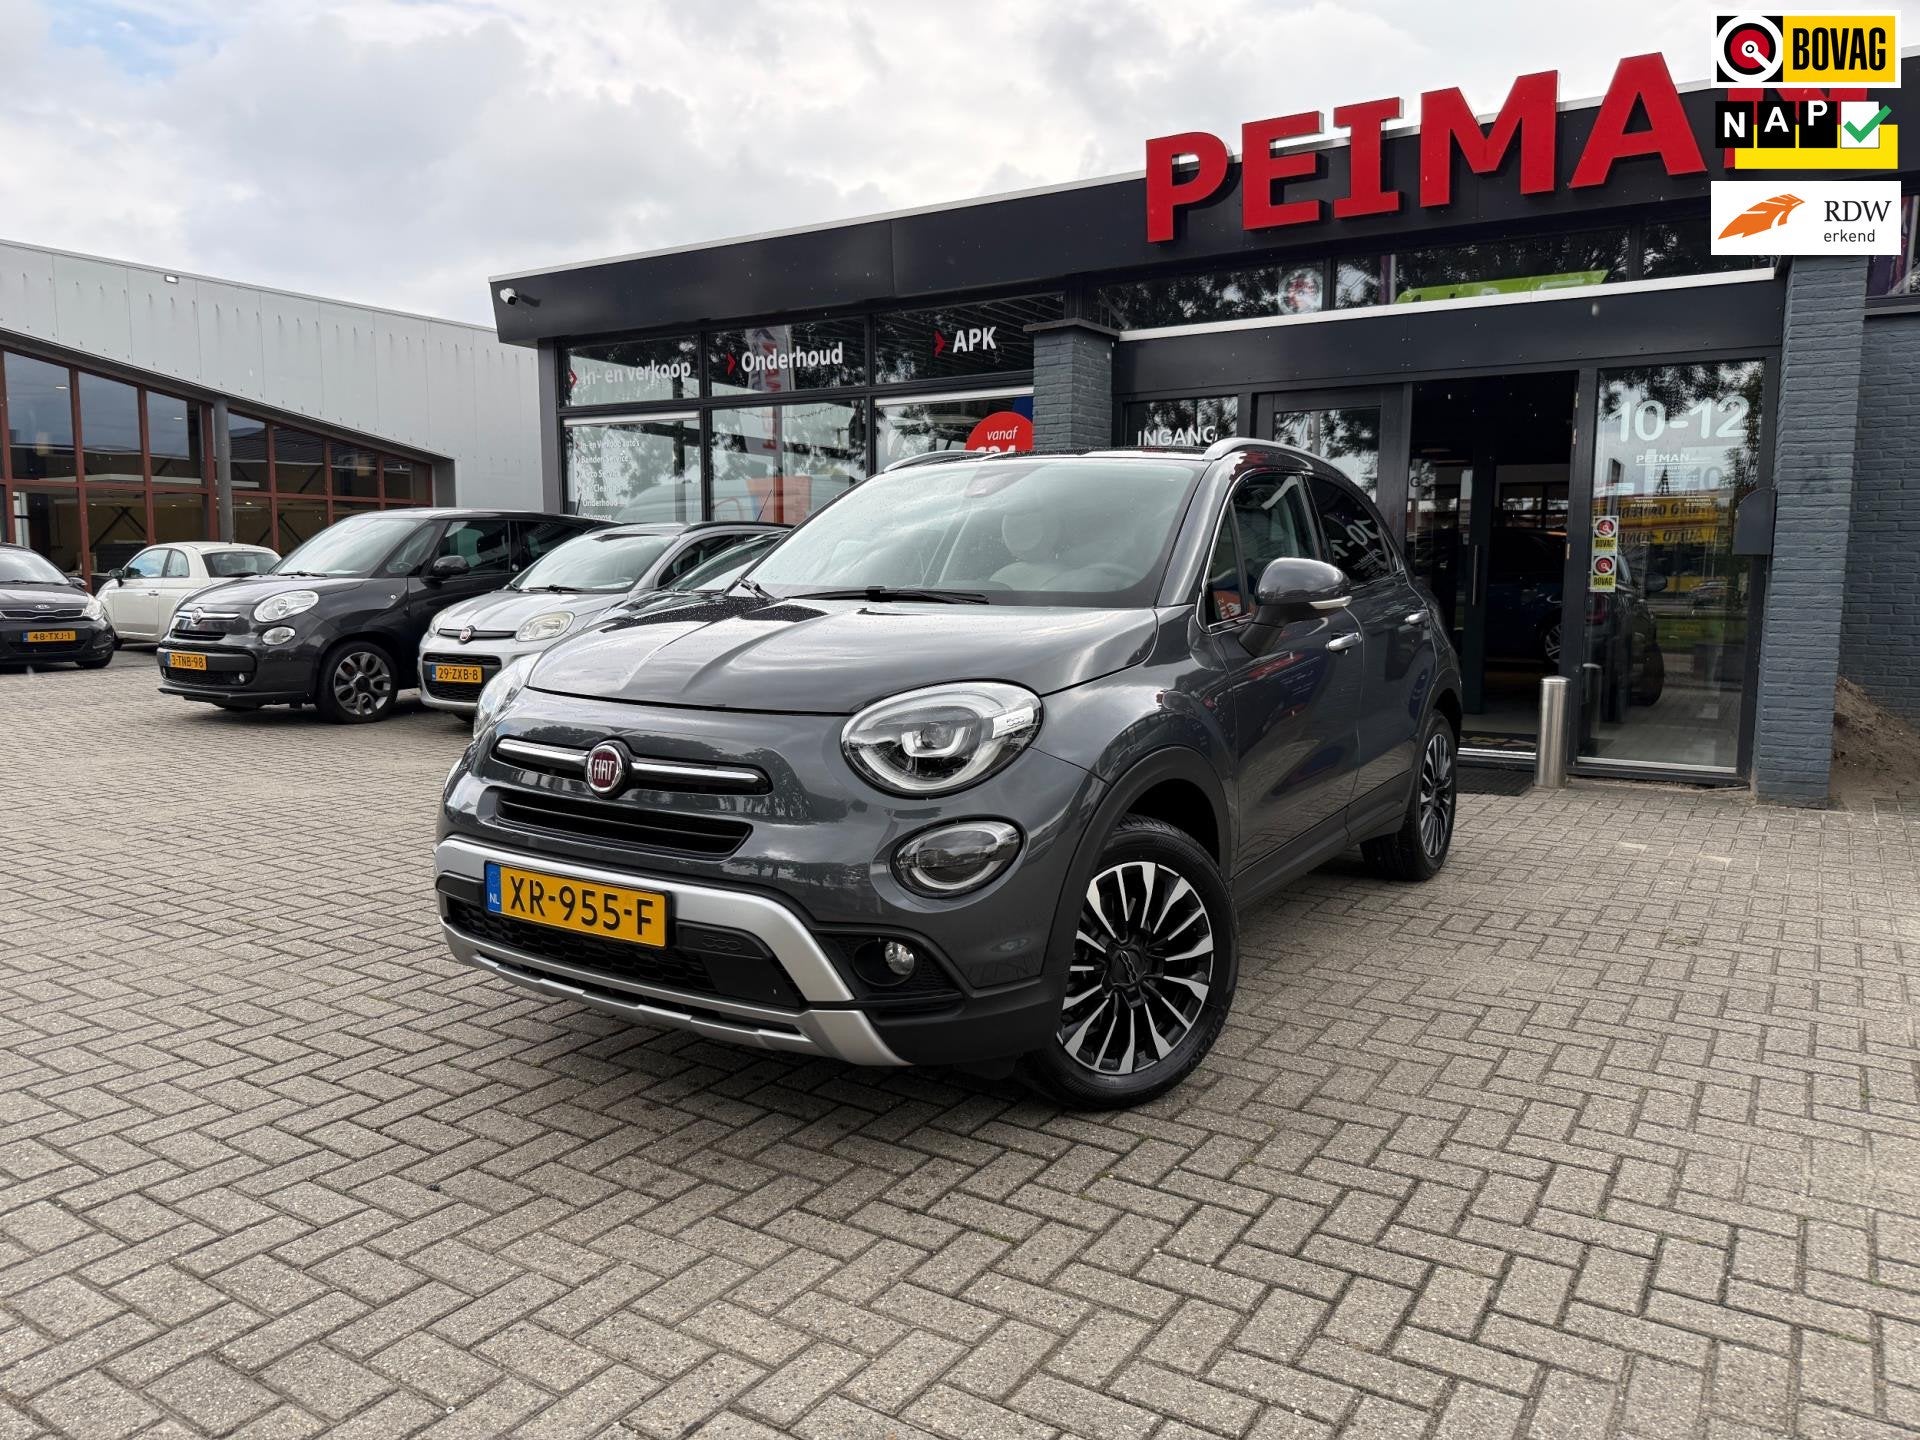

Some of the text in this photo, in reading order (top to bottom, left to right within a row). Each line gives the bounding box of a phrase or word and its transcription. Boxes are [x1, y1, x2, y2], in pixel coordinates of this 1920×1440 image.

[1146, 51, 1867, 243] PEIMA
[953, 326, 997, 353] APK
[741, 342, 843, 372] Onderhoud
[605, 369, 623, 383] en
[627, 360, 691, 382] verkoop
[1608, 395, 1750, 442] 10-12
[987, 426, 1018, 441] vanaf
[1137, 425, 1218, 446] INGANG
[439, 667, 478, 680] 29-ZXB-8
[594, 759, 615, 780] FIAT
[489, 892, 500, 904] NL
[510, 876, 653, 935] XR-955-F
